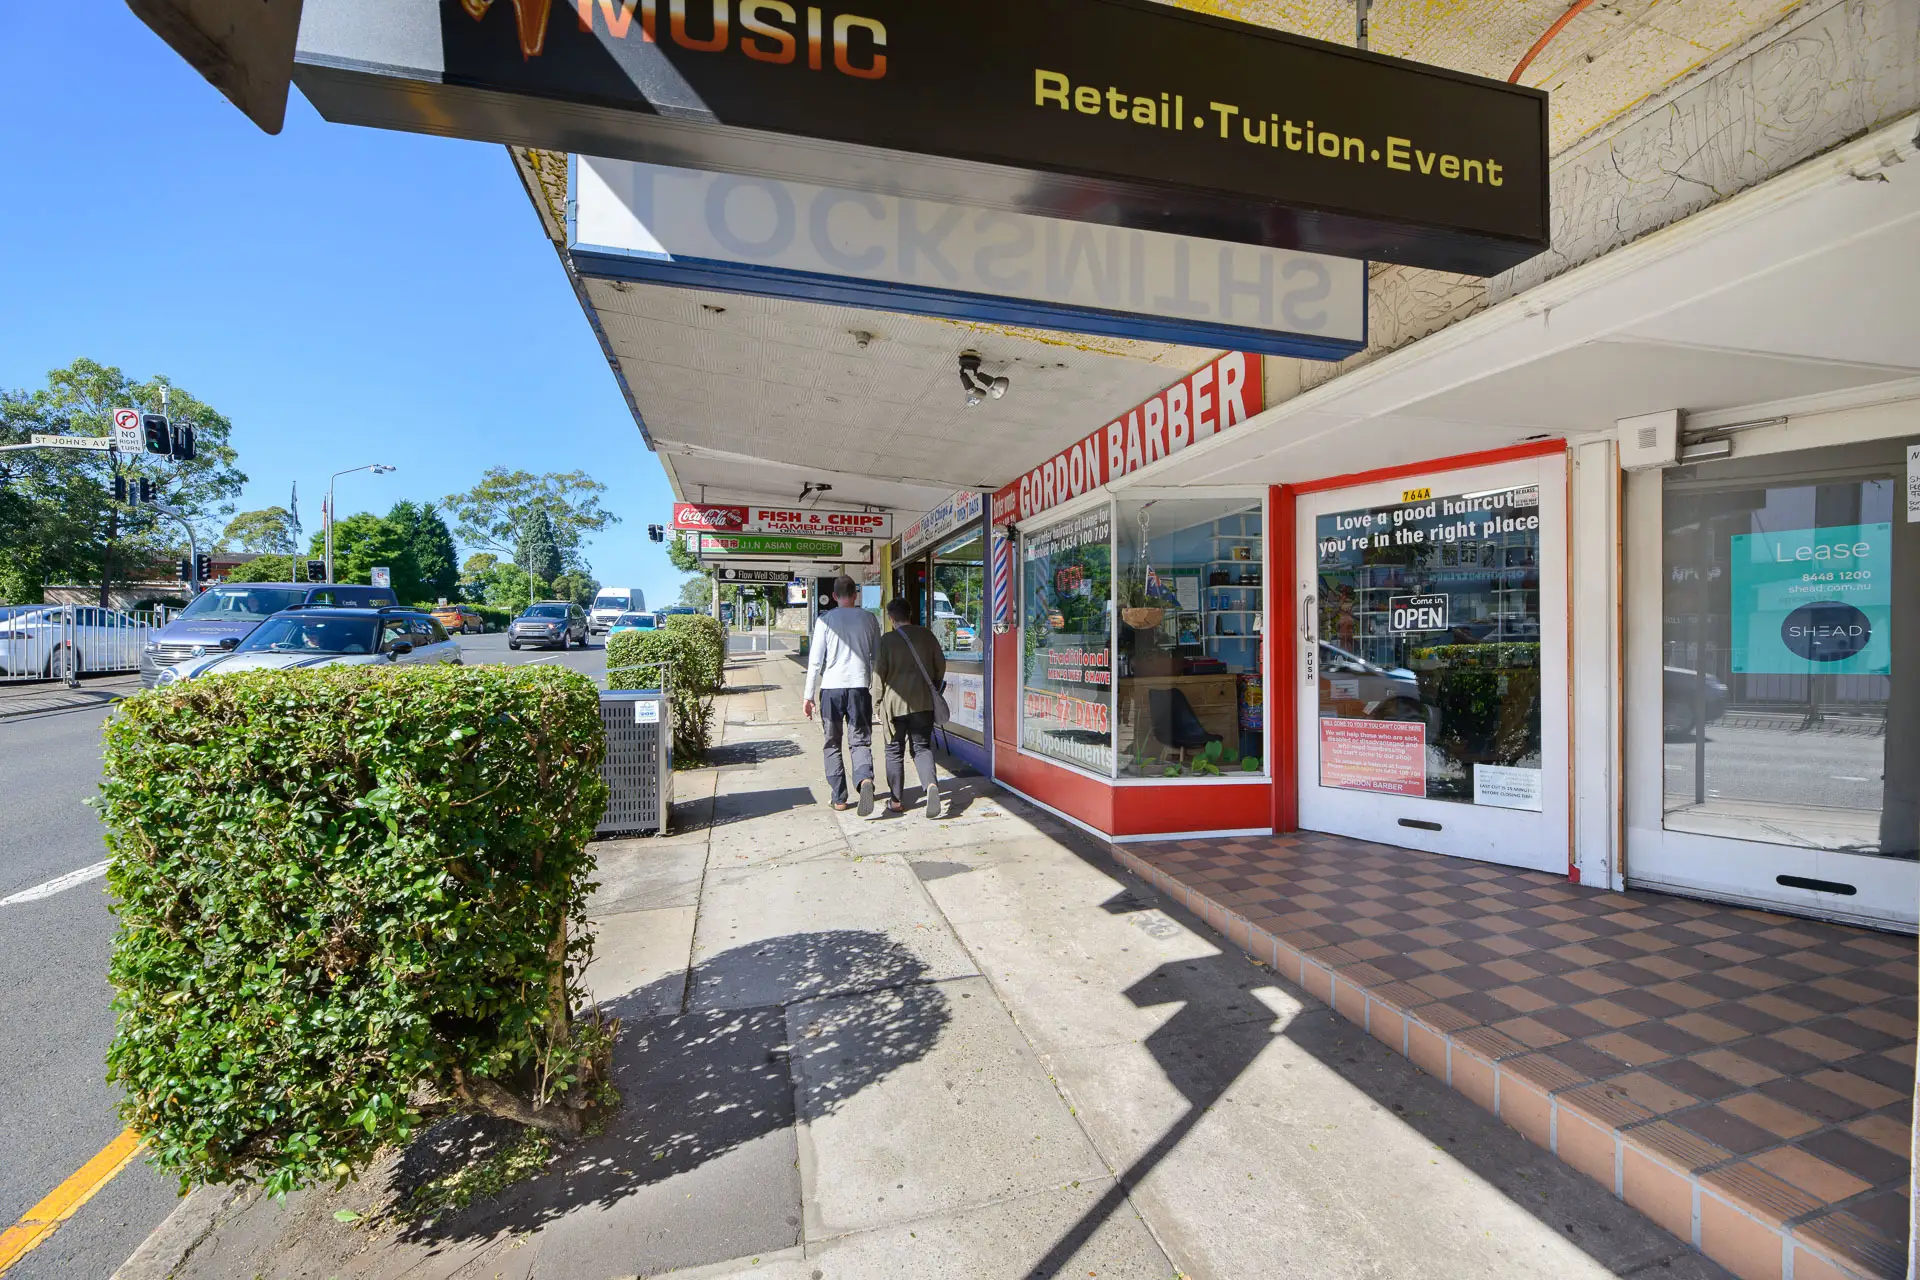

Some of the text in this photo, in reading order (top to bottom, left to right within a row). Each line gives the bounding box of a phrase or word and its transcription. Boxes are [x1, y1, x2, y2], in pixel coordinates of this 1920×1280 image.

[1035, 68, 1504, 188] Retail Tuition Event
[52, 438, 87, 446] JOHNS
[121, 431, 136, 439] NO
[1019, 350, 1247, 520] GORDON BARBER
[1403, 489, 1431, 501] 764A
[758, 510, 802, 523] FISH
[809, 514, 821, 524] &
[827, 514, 884, 527] CHIPS
[1081, 514, 1098, 530] home
[1099, 509, 1109, 523] for
[1336, 491, 1514, 531] Love a good haircut
[767, 522, 874, 534] HAMBURGERS
[1079, 529, 1096, 546] 100
[1095, 524, 1109, 540] 709
[1319, 515, 1539, 557] you're in the right place
[764, 541, 792, 550] ASIAN
[796, 542, 838, 551] GROCERY
[1776, 542, 1870, 562] Lease
[738, 570, 789, 581] Flow Well Studio
[1802, 570, 1871, 582] 8448 1200
[1788, 583, 1871, 594] shead.com.au
[1410, 596, 1444, 605] Come in
[1394, 607, 1443, 630] OPEN
[1789, 625, 1863, 638] SHEAD
[1049, 648, 1109, 667] Traditional
[1048, 668, 1111, 685] MEN'S WET SHAVE
[1027, 693, 1053, 720] OPEN
[1076, 701, 1108, 735] DAYS
[1024, 726, 1113, 769] No Appointments
[1341, 779, 1403, 791] GORDON BARBER
